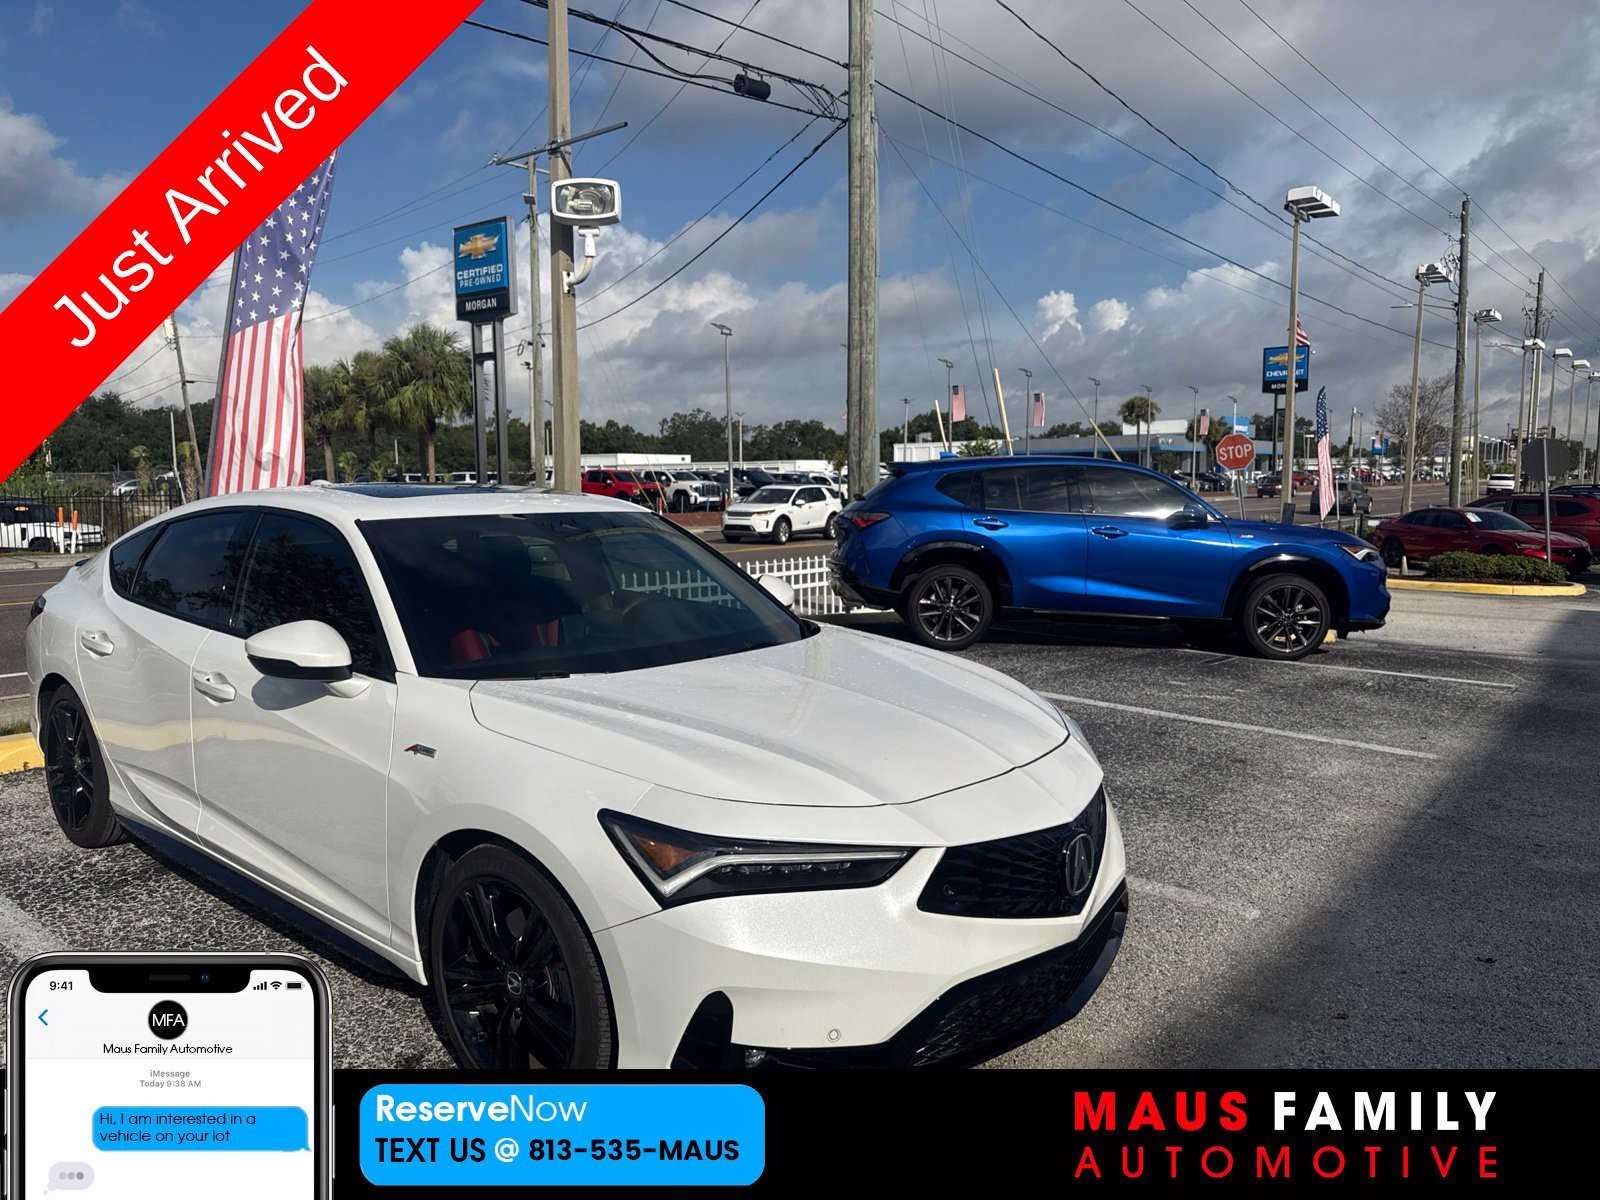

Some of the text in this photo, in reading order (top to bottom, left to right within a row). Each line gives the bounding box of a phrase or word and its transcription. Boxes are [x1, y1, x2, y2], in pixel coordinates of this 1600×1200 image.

[457, 263, 504, 280] CERTIFIED
[459, 273, 502, 288] PRE-OWNED
[465, 298, 497, 311] MORGAN
[1219, 443, 1252, 461] STOP
